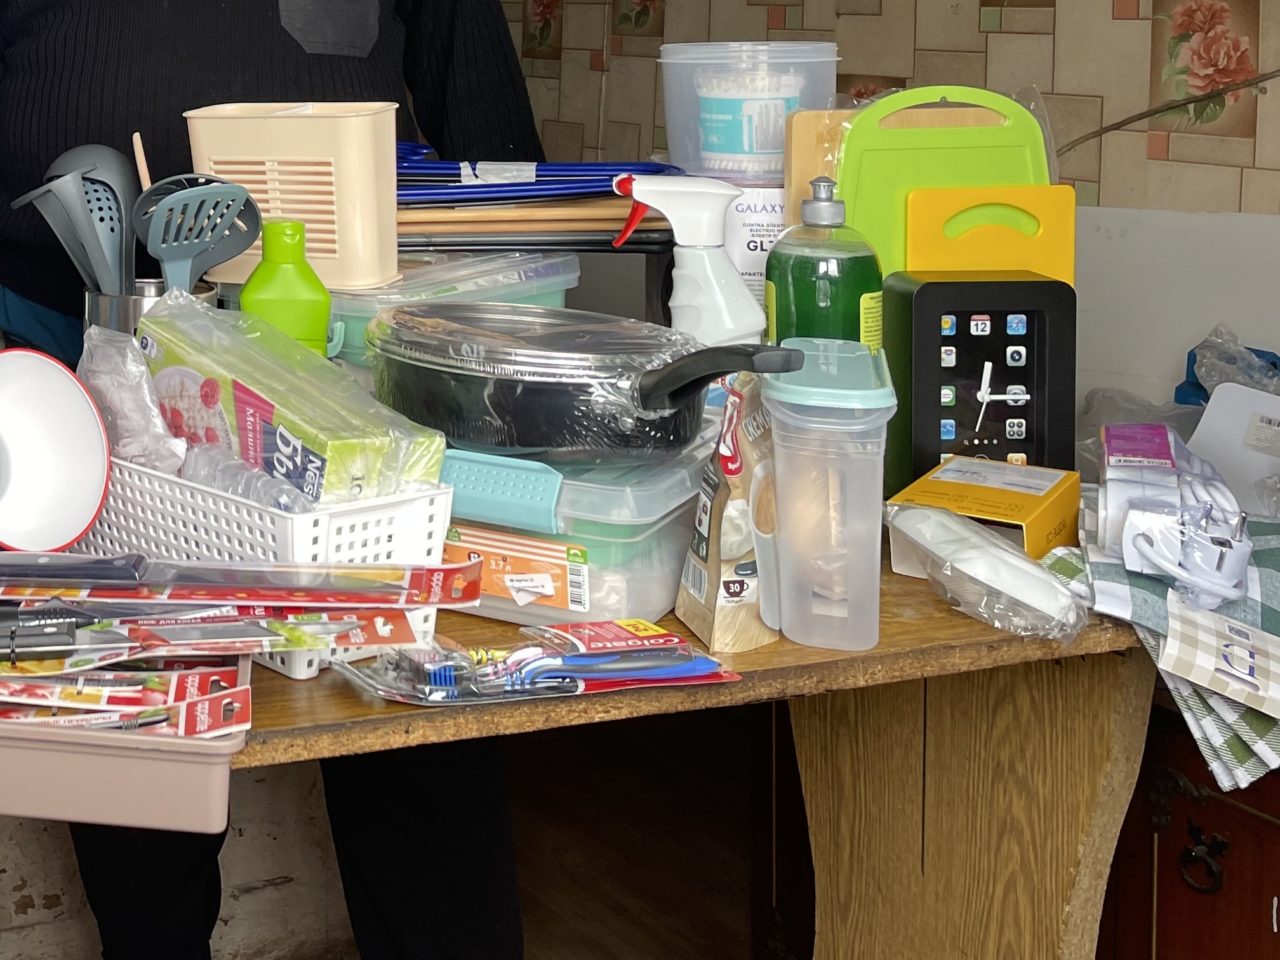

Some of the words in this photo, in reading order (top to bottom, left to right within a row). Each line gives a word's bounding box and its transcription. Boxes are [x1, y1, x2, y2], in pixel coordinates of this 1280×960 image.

[735, 203, 785, 214] GALAXY
[973, 322, 987, 333] 12
[303, 455, 322, 500] Nes
[489, 559, 505, 570] 3.7
[728, 582, 740, 593] 30
[590, 636, 681, 648] Colgate
